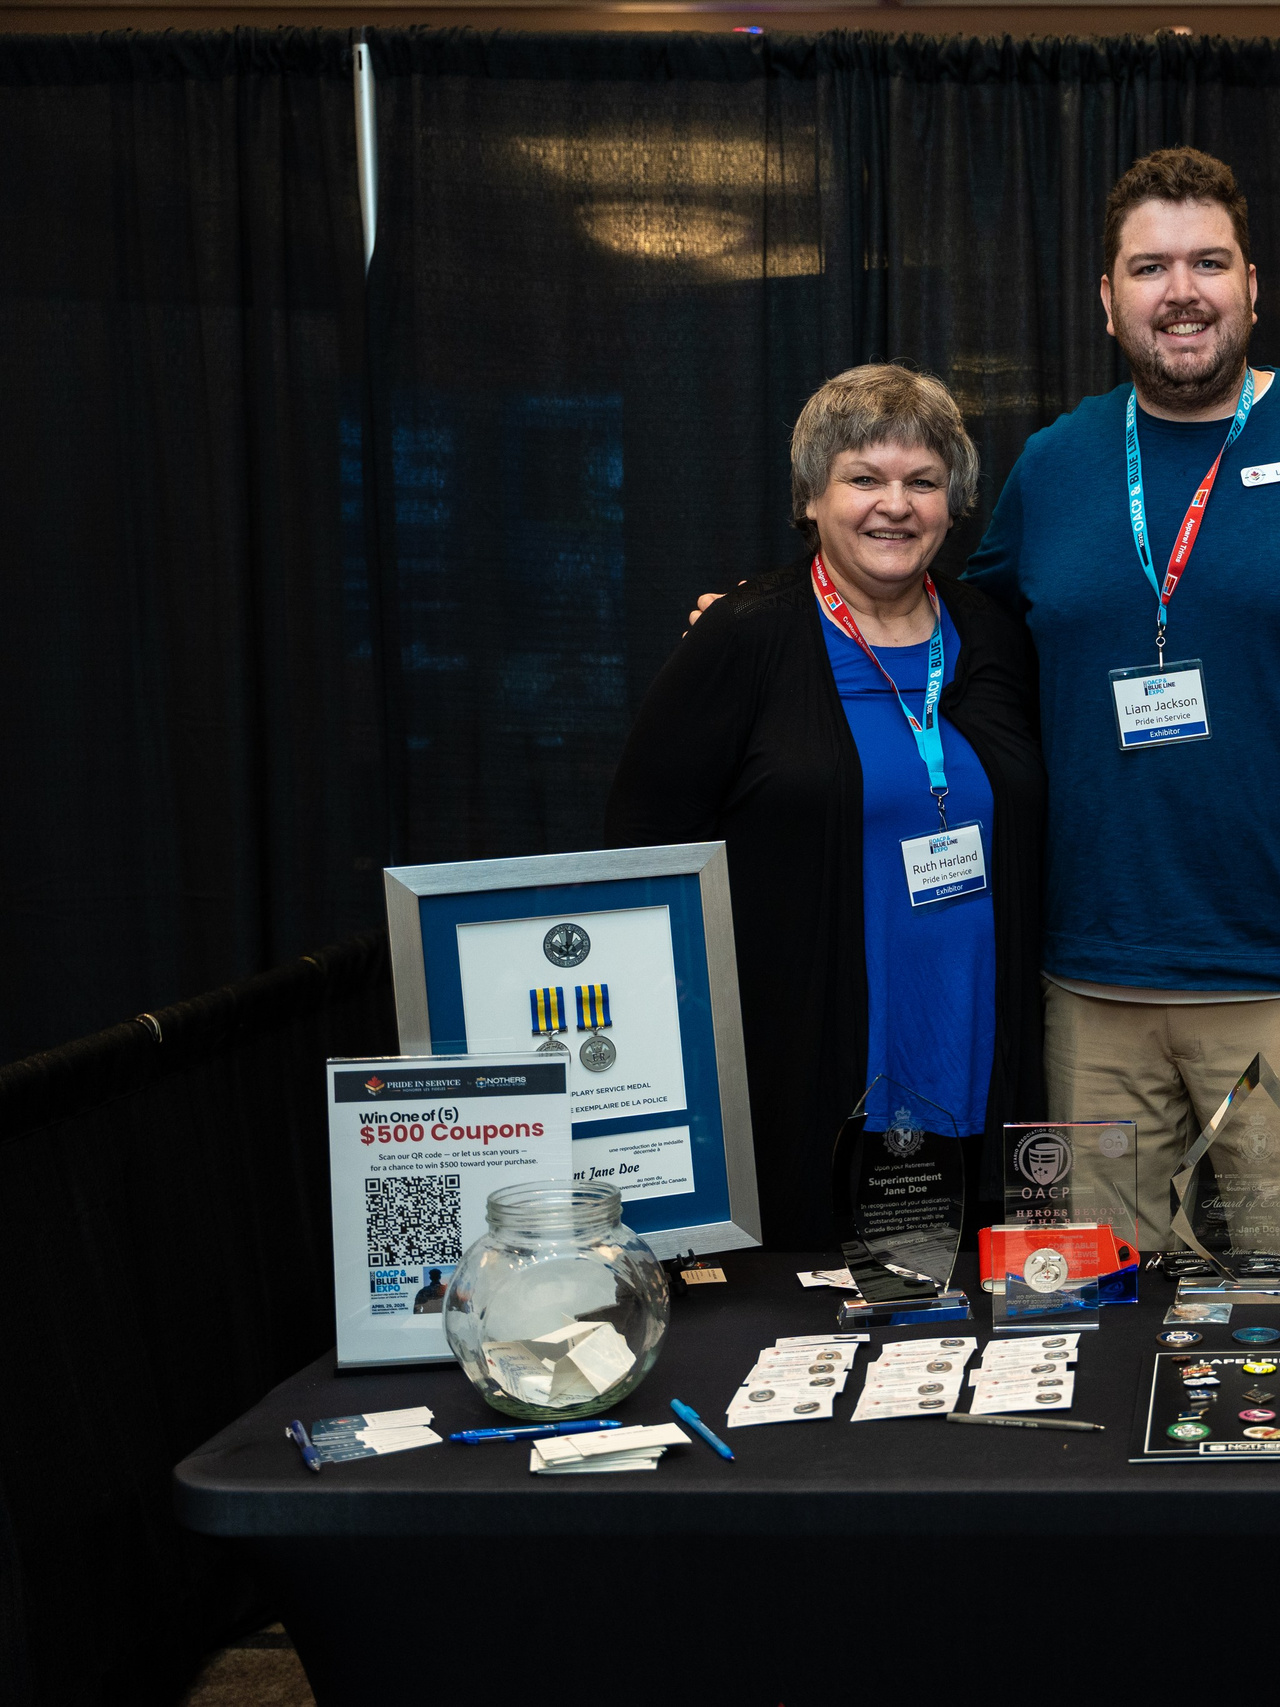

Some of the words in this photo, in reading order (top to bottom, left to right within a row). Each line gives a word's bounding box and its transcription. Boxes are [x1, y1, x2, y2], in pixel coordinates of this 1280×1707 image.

[1242, 379, 1254, 410] OACP
[1127, 394, 1136, 428] EXPO
[1127, 426, 1137, 451] LINE
[1129, 455, 1139, 486] BLUE
[1131, 484, 1141, 496] &
[1131, 499, 1144, 532] OACP
[1184, 518, 1195, 546] Apparel
[1175, 543, 1188, 564] Trims
[931, 641, 942, 668] BLUE
[930, 668, 942, 678] &
[927, 680, 941, 704] OACP
[1125, 704, 1151, 716] Liam
[1154, 697, 1198, 711] Jackson
[1135, 717, 1155, 726] Pride
[1164, 712, 1191, 722] Service
[1149, 728, 1181, 738] Exhibitor
[912, 860, 937, 875] Ruth
[939, 850, 978, 868] Harland
[922, 875, 940, 885] Pride
[941, 873, 948, 881] in
[948, 868, 972, 879] Service
[936, 884, 964, 896] Exhibitor
[386, 1080, 414, 1089] PRIDE
[415, 1079, 424, 1088] IN
[425, 1078, 461, 1087] SERVICE
[486, 1076, 526, 1084] NOTHERS
[596, 1085, 626, 1094] SERVICE
[627, 1082, 651, 1090] MEDAL
[575, 1102, 619, 1113] EXEMPLAIRE
[643, 1096, 668, 1104] POLICE
[359, 1112, 388, 1125] Win
[390, 1111, 419, 1123] One
[421, 1109, 436, 1122] of
[438, 1107, 459, 1123] (5)
[360, 1123, 425, 1146] $500
[431, 1122, 544, 1145] Coupons
[619, 1143, 650, 1152] reproduction
[379, 1153, 396, 1161] Scan
[397, 1153, 410, 1161] our
[411, 1152, 423, 1160] QR
[425, 1151, 442, 1159] code
[500, 1149, 519, 1157] yours
[370, 1164, 381, 1172] for
[388, 1163, 414, 1171] chance
[440, 1160, 459, 1169] $500
[460, 1160, 486, 1168] toward
[487, 1160, 503, 1168] your
[504, 1158, 539, 1167] purchase.
[589, 1166, 615, 1181] Jane
[619, 1163, 640, 1175] Doe
[904, 1161, 935, 1169] Retirement
[868, 1173, 942, 1187] Superintendent
[884, 1187, 906, 1196] Jane
[908, 1185, 928, 1194] Doe
[1021, 1186, 1070, 1199] OACP
[1201, 1195, 1246, 1209] Award
[1246, 1195, 1257, 1212] of
[1016, 1208, 1069, 1218] HEROES
[1074, 1207, 1126, 1216] BEYOND
[1238, 1225, 1260, 1234] Jane
[1262, 1225, 1280, 1233] Doe
[376, 1270, 399, 1278] OACP
[400, 1269, 407, 1277] &
[376, 1277, 398, 1286] BLUE
[400, 1276, 419, 1284] LINE
[376, 1284, 401, 1293] EXPO
